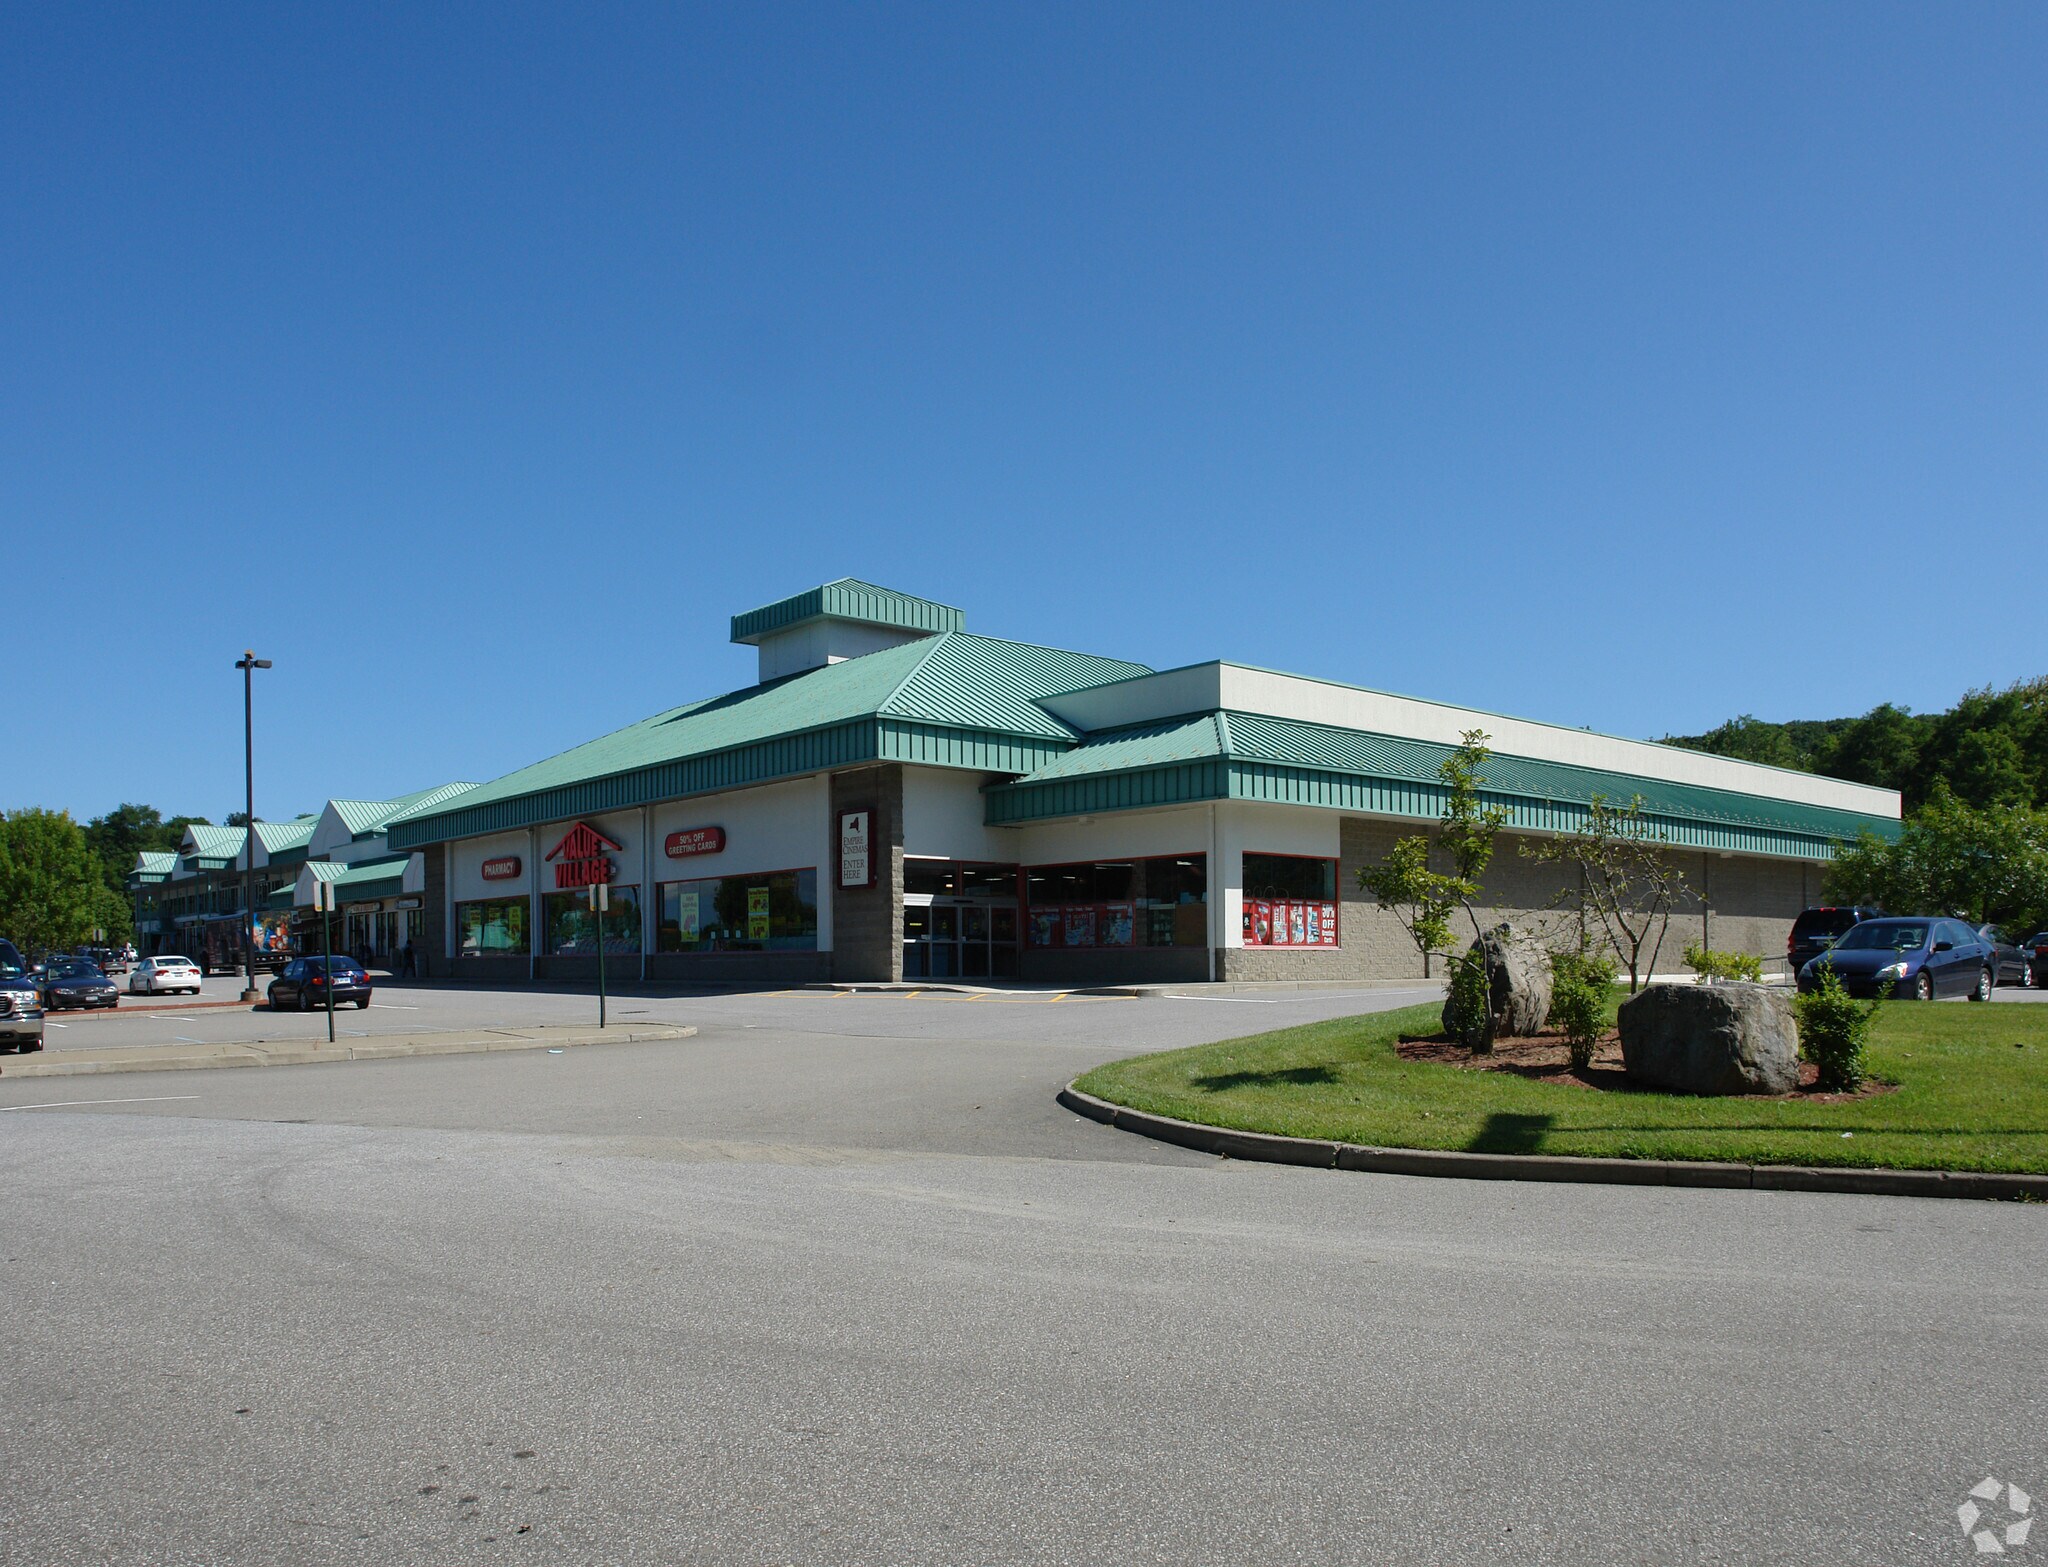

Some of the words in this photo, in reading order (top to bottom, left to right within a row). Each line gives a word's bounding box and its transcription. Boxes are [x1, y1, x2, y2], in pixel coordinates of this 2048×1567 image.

[680, 834, 692, 845] 50%
[693, 832, 705, 842] OFF
[843, 836, 864, 846] EMPIRE
[563, 829, 598, 860] VALUE
[668, 843, 696, 855] GREETING
[697, 840, 717, 851] CARDS
[842, 846, 868, 855] CINEMAS
[484, 861, 514, 876] PHARMACY
[843, 859, 865, 869] ENTER
[555, 857, 609, 888] VILLAGE
[843, 870, 861, 879] HERE
[1322, 919, 1335, 929] OFF
